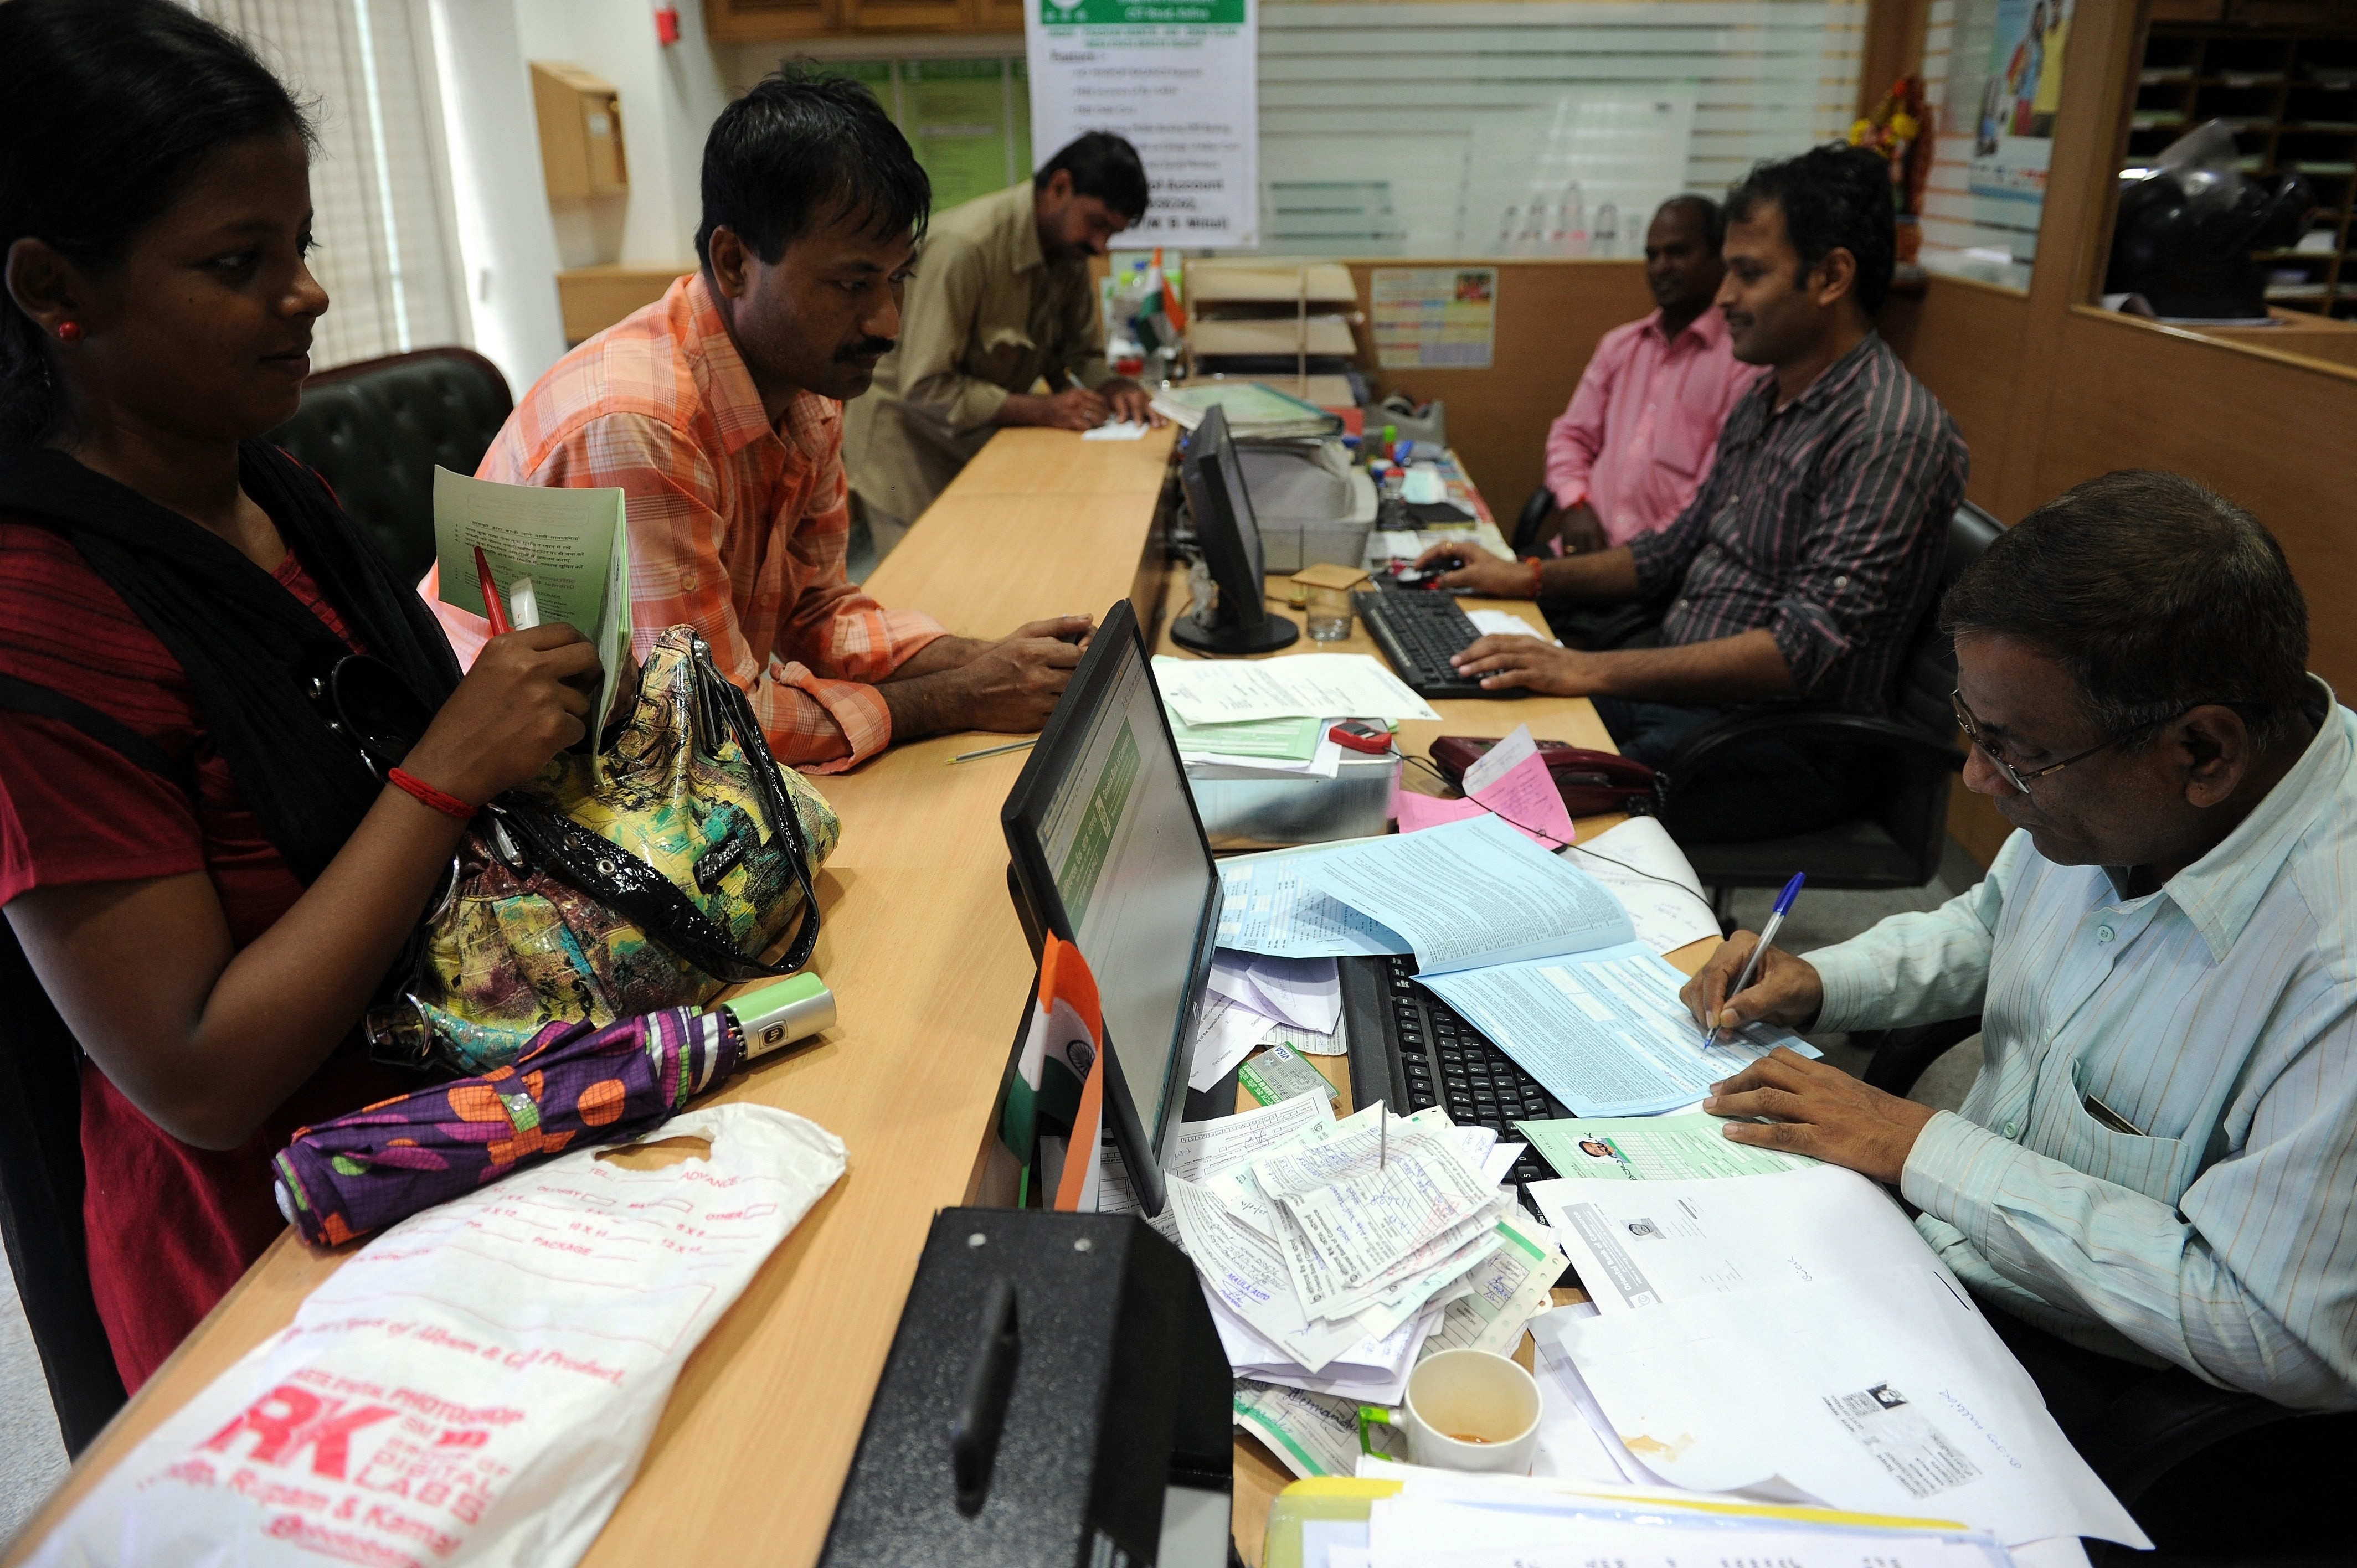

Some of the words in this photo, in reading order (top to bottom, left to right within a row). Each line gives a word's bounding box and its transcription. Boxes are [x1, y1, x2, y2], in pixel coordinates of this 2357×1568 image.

[1276, 1047, 1289, 1059] VISA
[680, 1170, 740, 1188] ADVANCE
[704, 1211, 743, 1221] OTHER
[1312, 1210, 1333, 1238] Commerce
[1573, 1212, 1597, 1241] Commerce
[532, 1237, 593, 1256] PACKAGE
[1335, 1244, 1345, 1256] Bank
[1601, 1249, 1614, 1265] Bank
[1227, 1273, 1251, 1290] MAULA
[1252, 1289, 1269, 1300] AUTO
[1612, 1266, 1631, 1290] Oriental
[192, 1385, 399, 1482] RK
[354, 1464, 489, 1526] LABS
